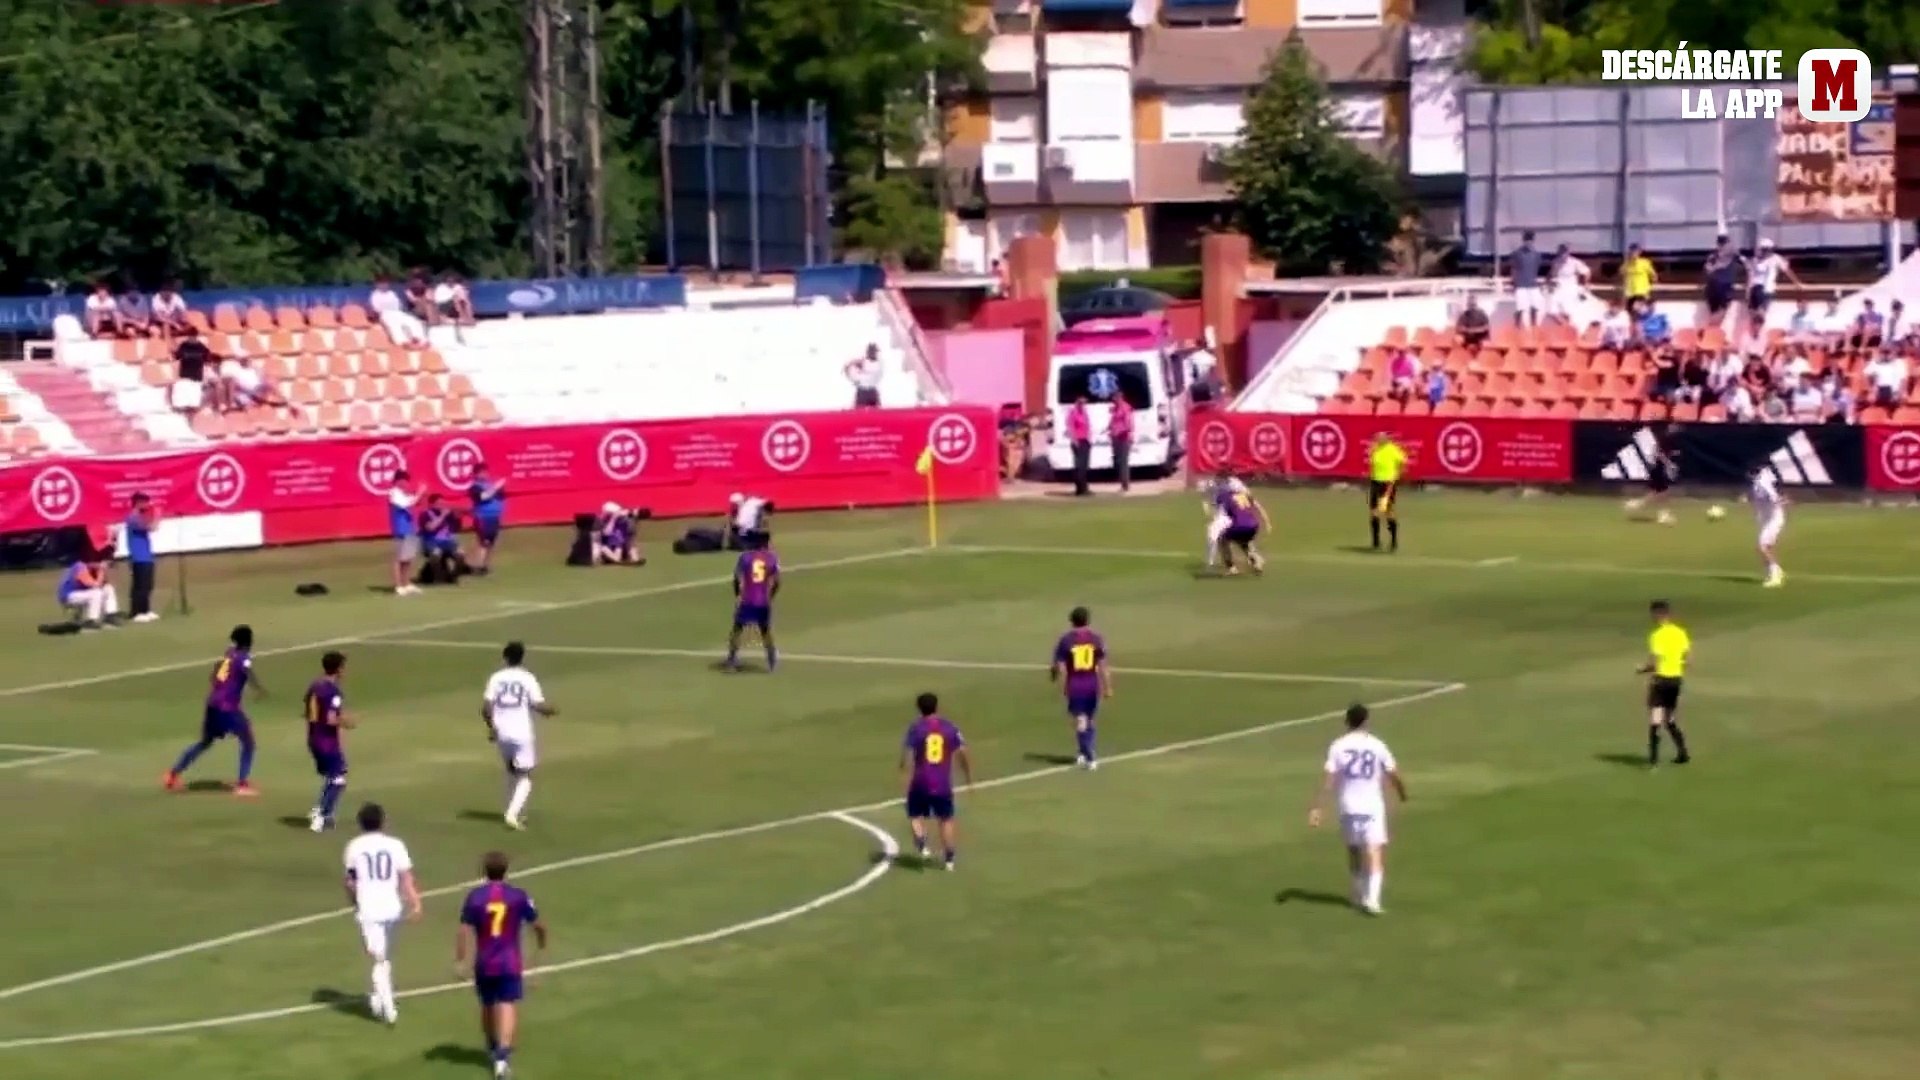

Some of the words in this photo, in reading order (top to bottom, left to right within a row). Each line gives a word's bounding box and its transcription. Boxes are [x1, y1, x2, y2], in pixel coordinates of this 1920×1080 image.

[752, 558, 766, 583] 5
[1070, 643, 1095, 670] 10
[498, 681, 523, 709] 29
[925, 733, 945, 764] 8
[1343, 749, 1376, 779] 28
[362, 850, 393, 881] 10
[486, 901, 508, 938] 7
